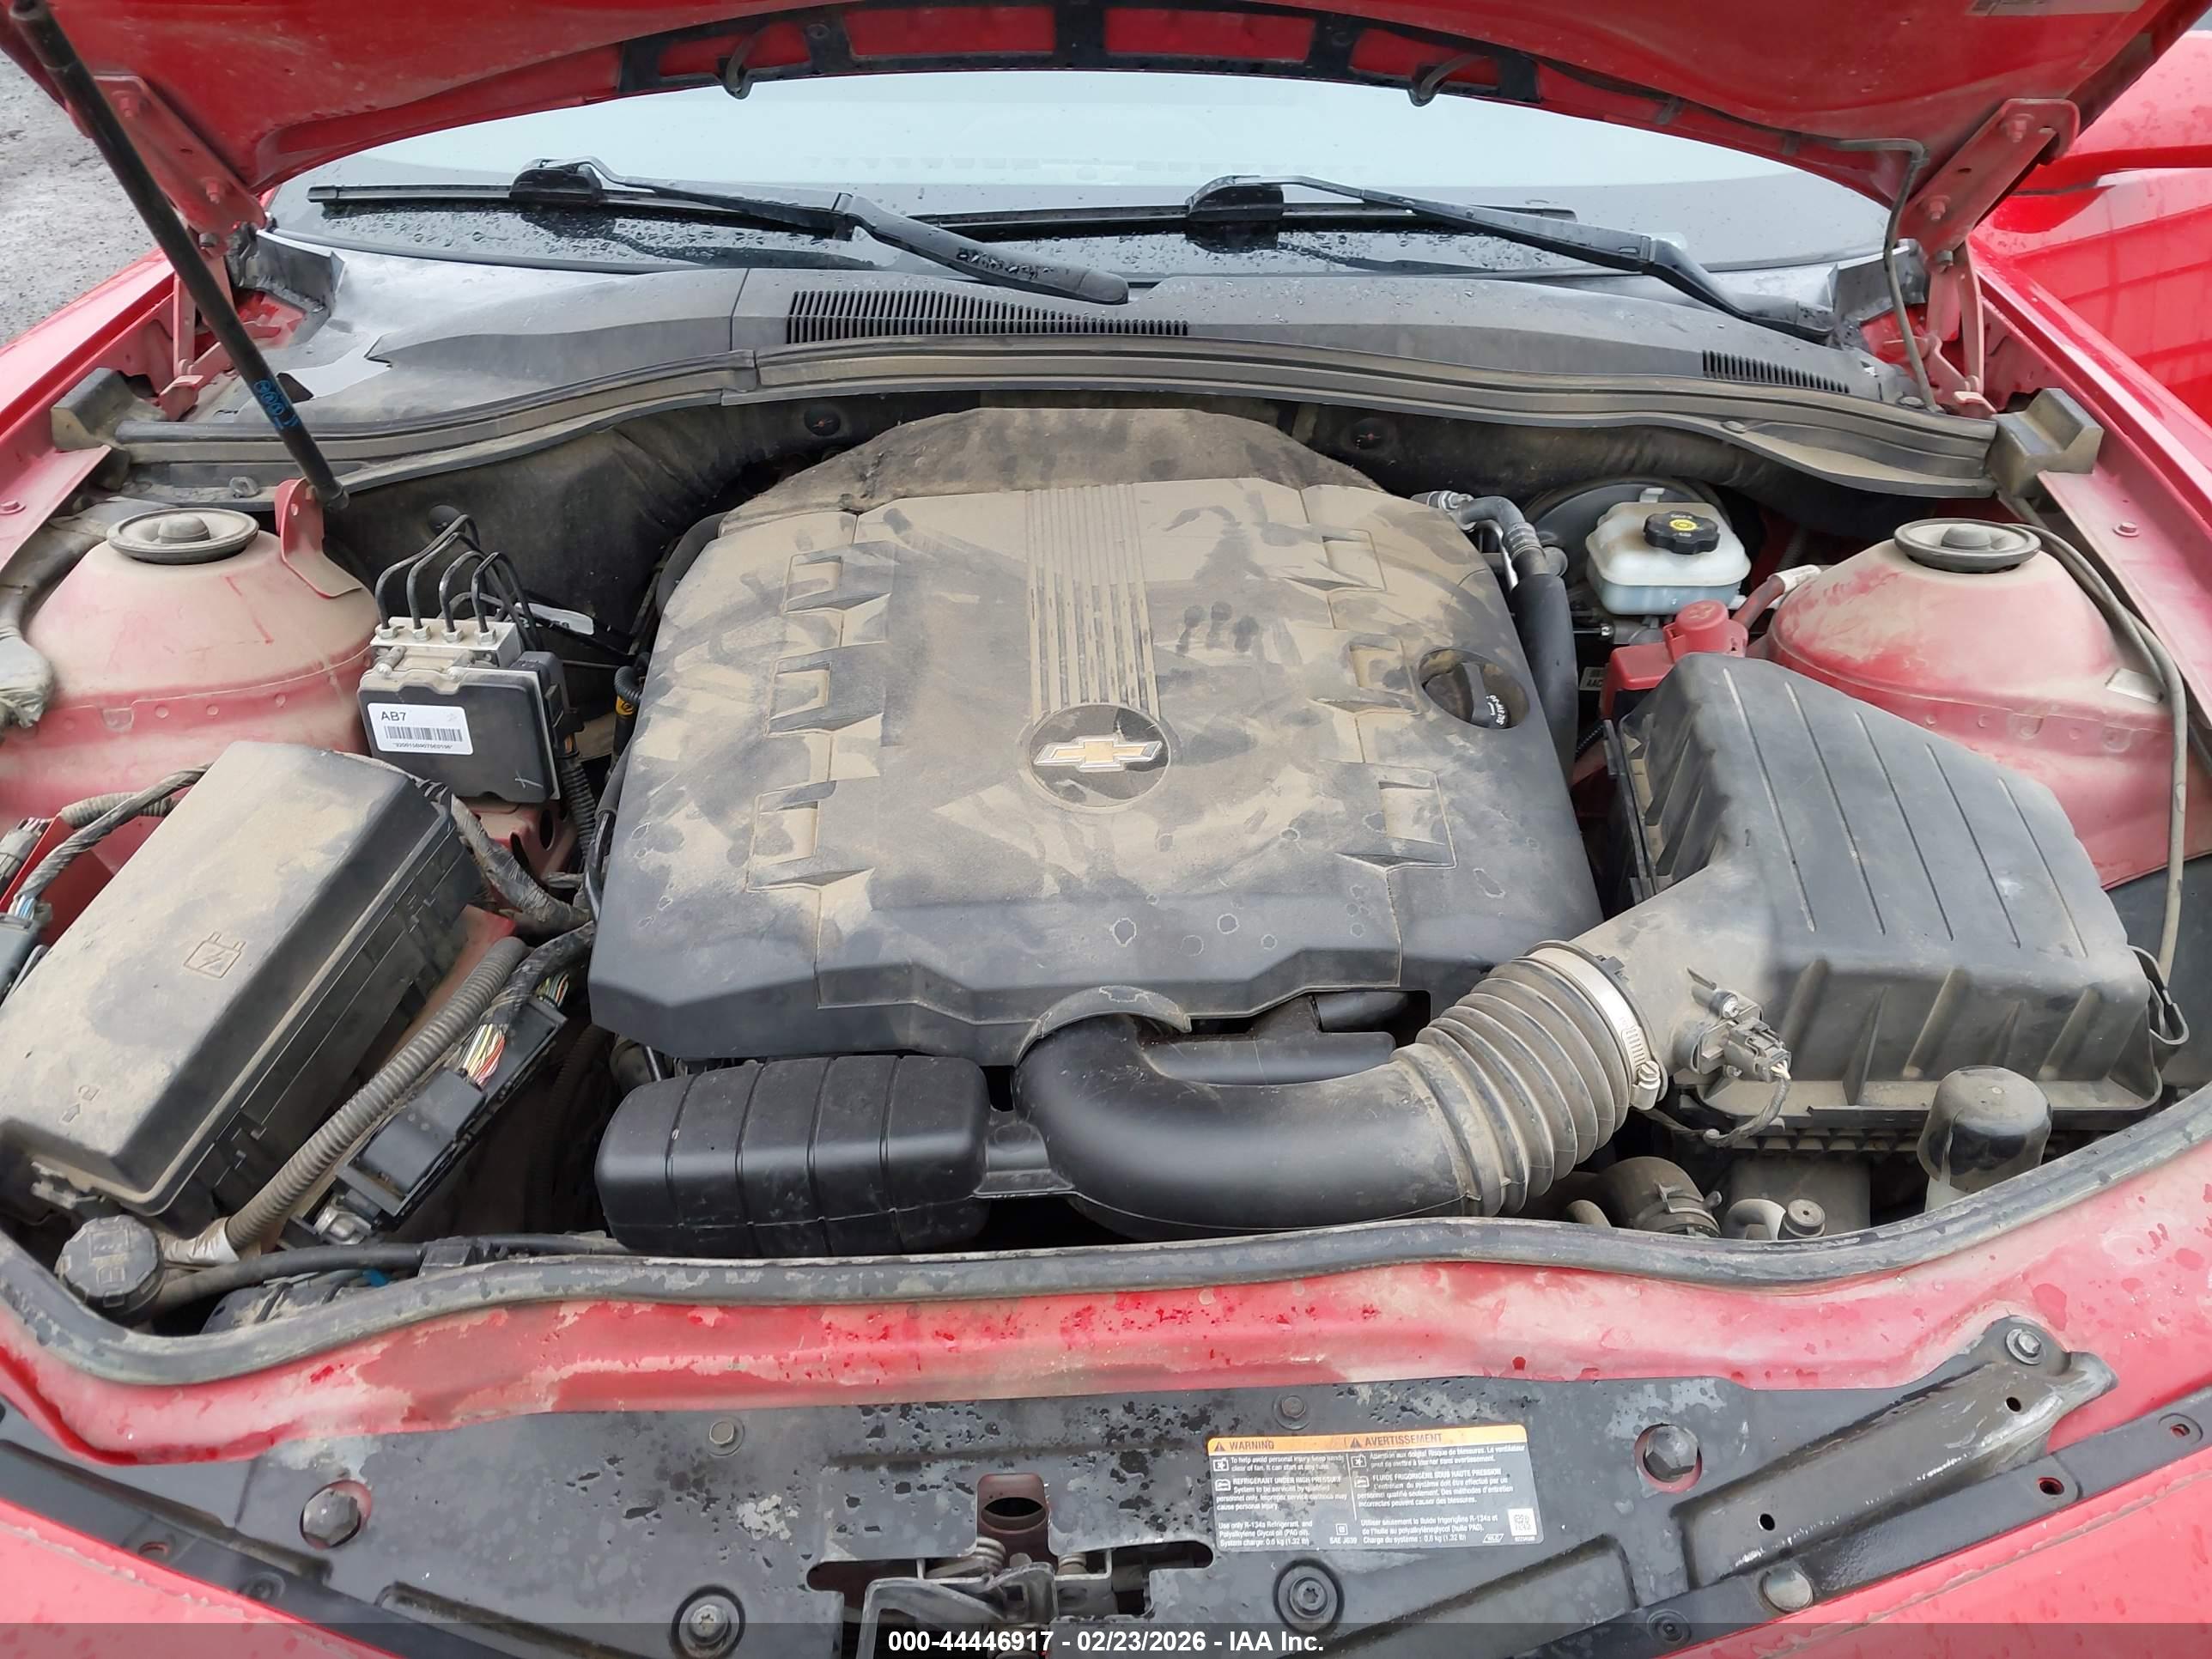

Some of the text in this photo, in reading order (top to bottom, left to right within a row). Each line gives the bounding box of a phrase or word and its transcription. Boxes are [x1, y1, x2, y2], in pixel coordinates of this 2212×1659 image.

[381, 711, 406, 721] AB7
[1365, 1433, 1443, 1446] AVERTISSEMENT
[1229, 1439, 1275, 1451] WARNING
[1370, 1451, 1395, 1459] Attention
[1428, 1449, 1448, 1457] Risque
[1495, 1444, 1526, 1452] ventilateur
[1454, 1454, 1496, 1463] avertissement.
[1471, 1467, 1502, 1476] PRESSION
[1233, 1485, 1256, 1494] System
[1260, 1494, 1283, 1502] Improper
[1267, 1520, 1299, 1529] Refrigerant
[1452, 1524, 1468, 1532] (huile
[1220, 1530, 1256, 1539] Polyalkylene
[1257, 1529, 1275, 1538] Glycol
[1220, 1539, 1243, 1547] System
[1363, 1535, 1385, 1545] Charge
